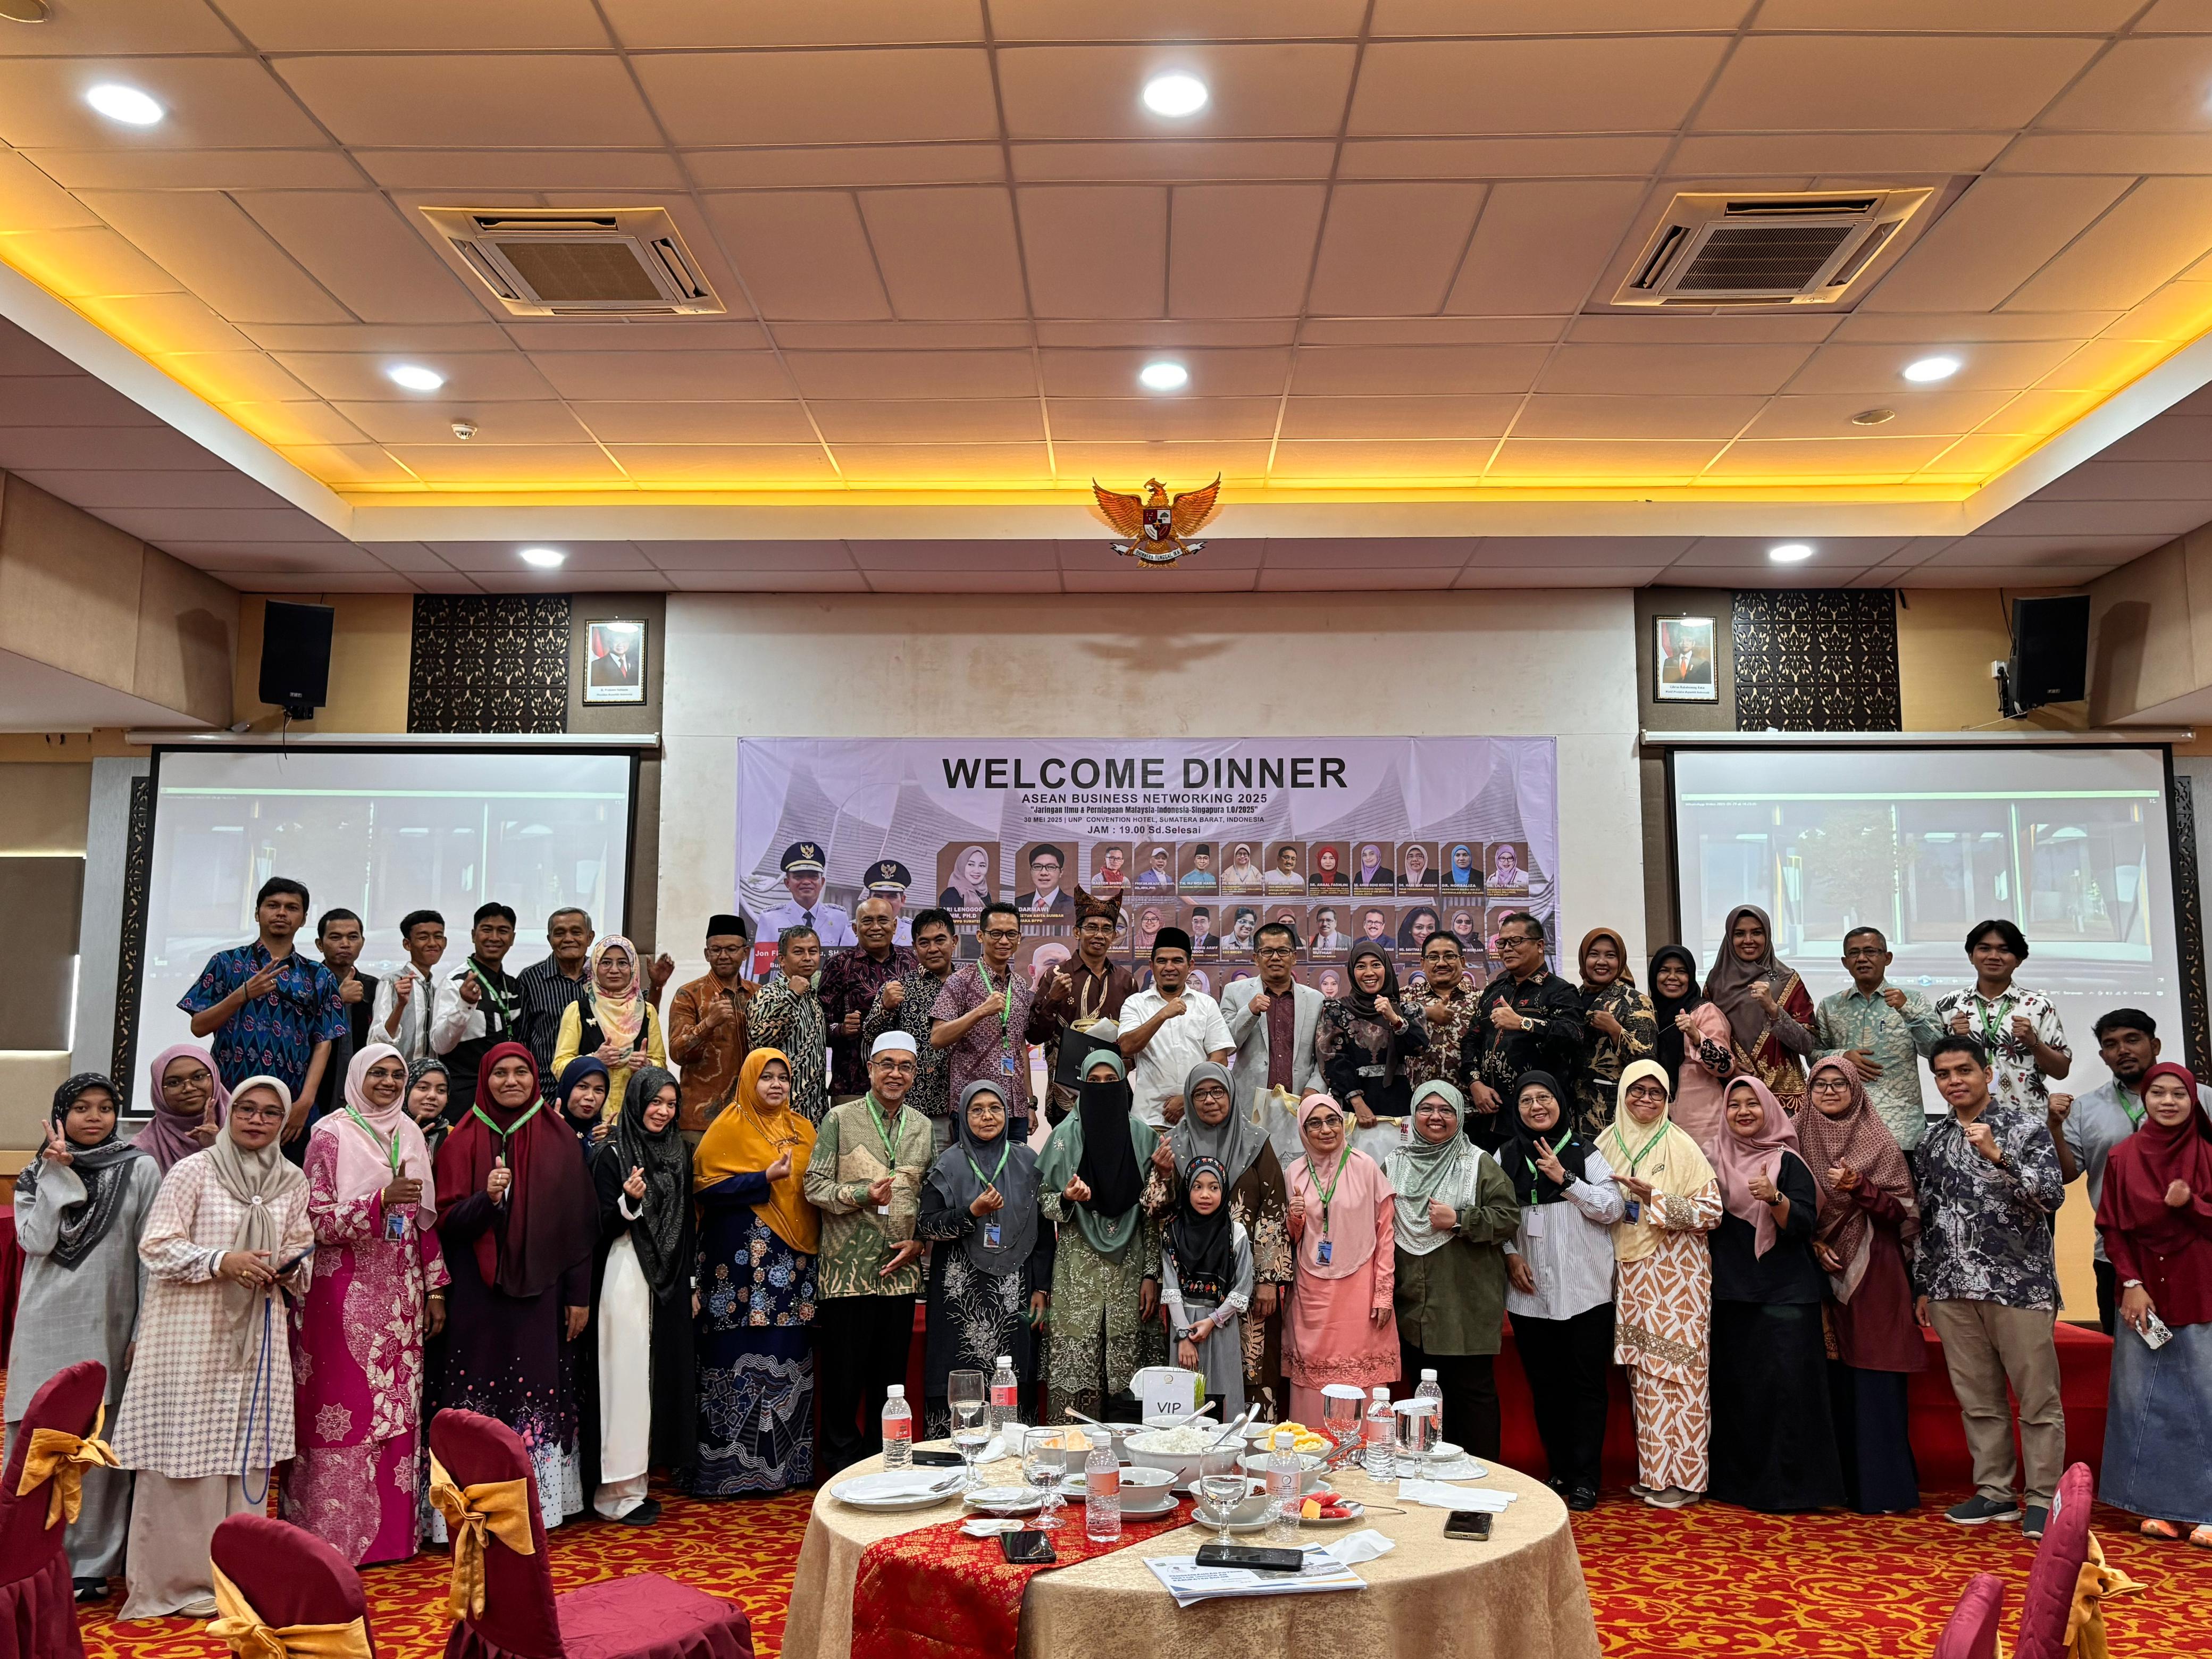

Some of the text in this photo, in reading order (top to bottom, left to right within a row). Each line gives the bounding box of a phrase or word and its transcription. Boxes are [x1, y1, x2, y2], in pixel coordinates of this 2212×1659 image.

[942, 757, 1348, 789] WELCOME DINNER
[1021, 793, 1267, 803] ASEAN BUSINESS NETWORKING 2025
[1086, 806, 1123, 815] Perniagaan
[1157, 1402, 1181, 1414] VIP
